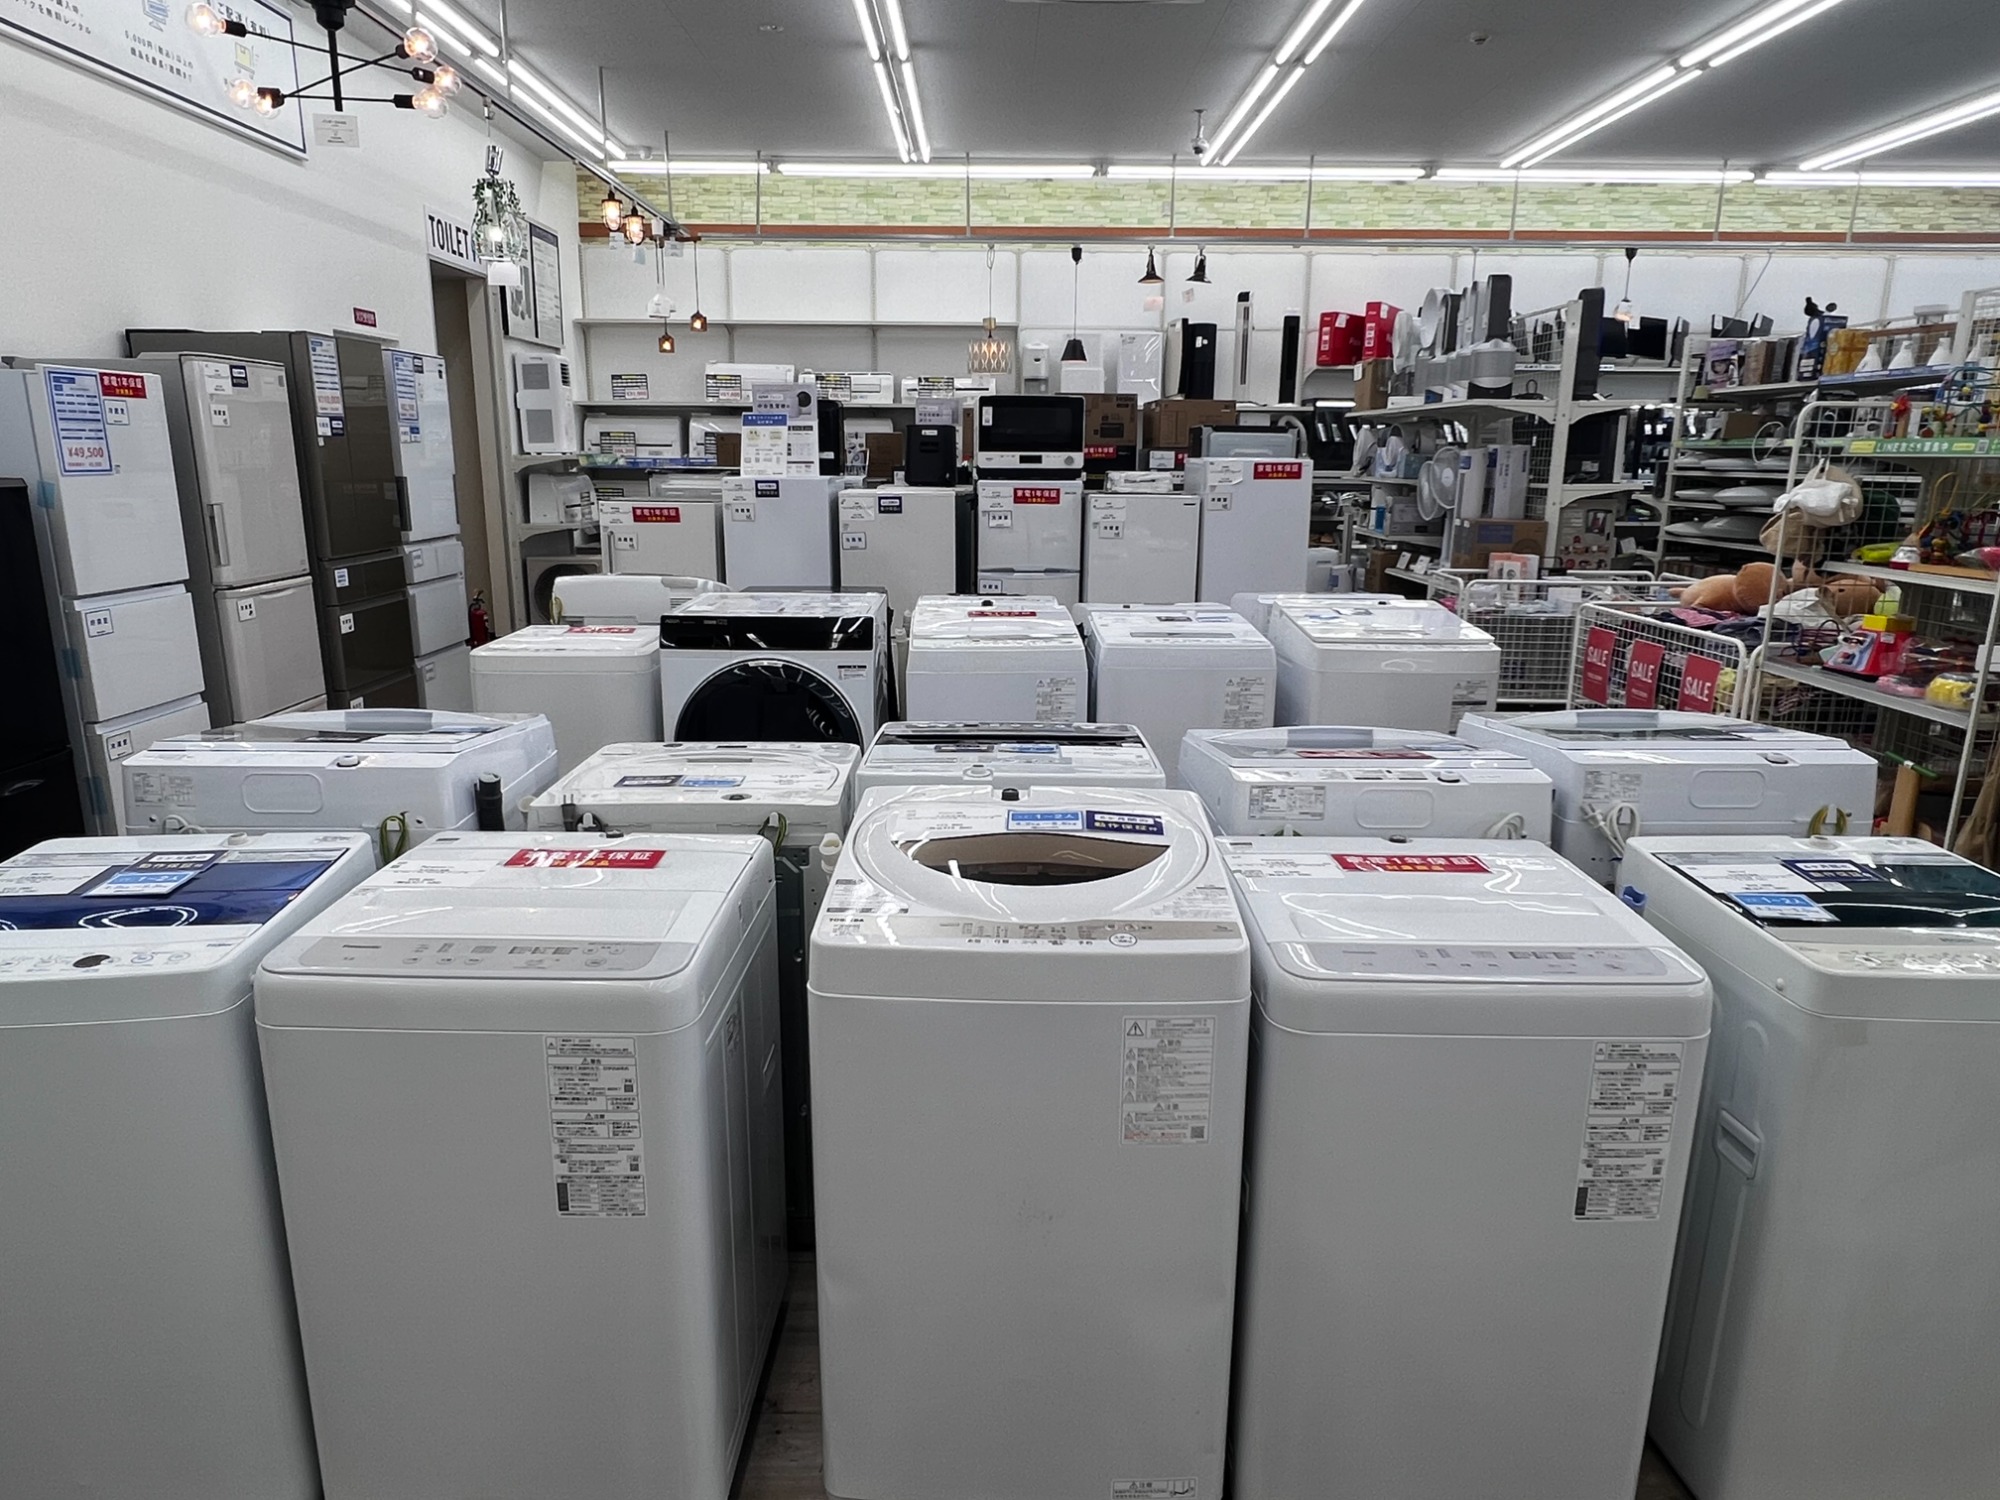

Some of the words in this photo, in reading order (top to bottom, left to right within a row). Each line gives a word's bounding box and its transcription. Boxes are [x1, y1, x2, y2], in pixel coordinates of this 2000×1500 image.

[428, 215, 469, 260] TOILET
[67, 446, 104, 459] ¥49,500
[1587, 646, 1609, 667] SALE
[1631, 661, 1655, 683] SALE
[1683, 676, 1712, 702] SALE
